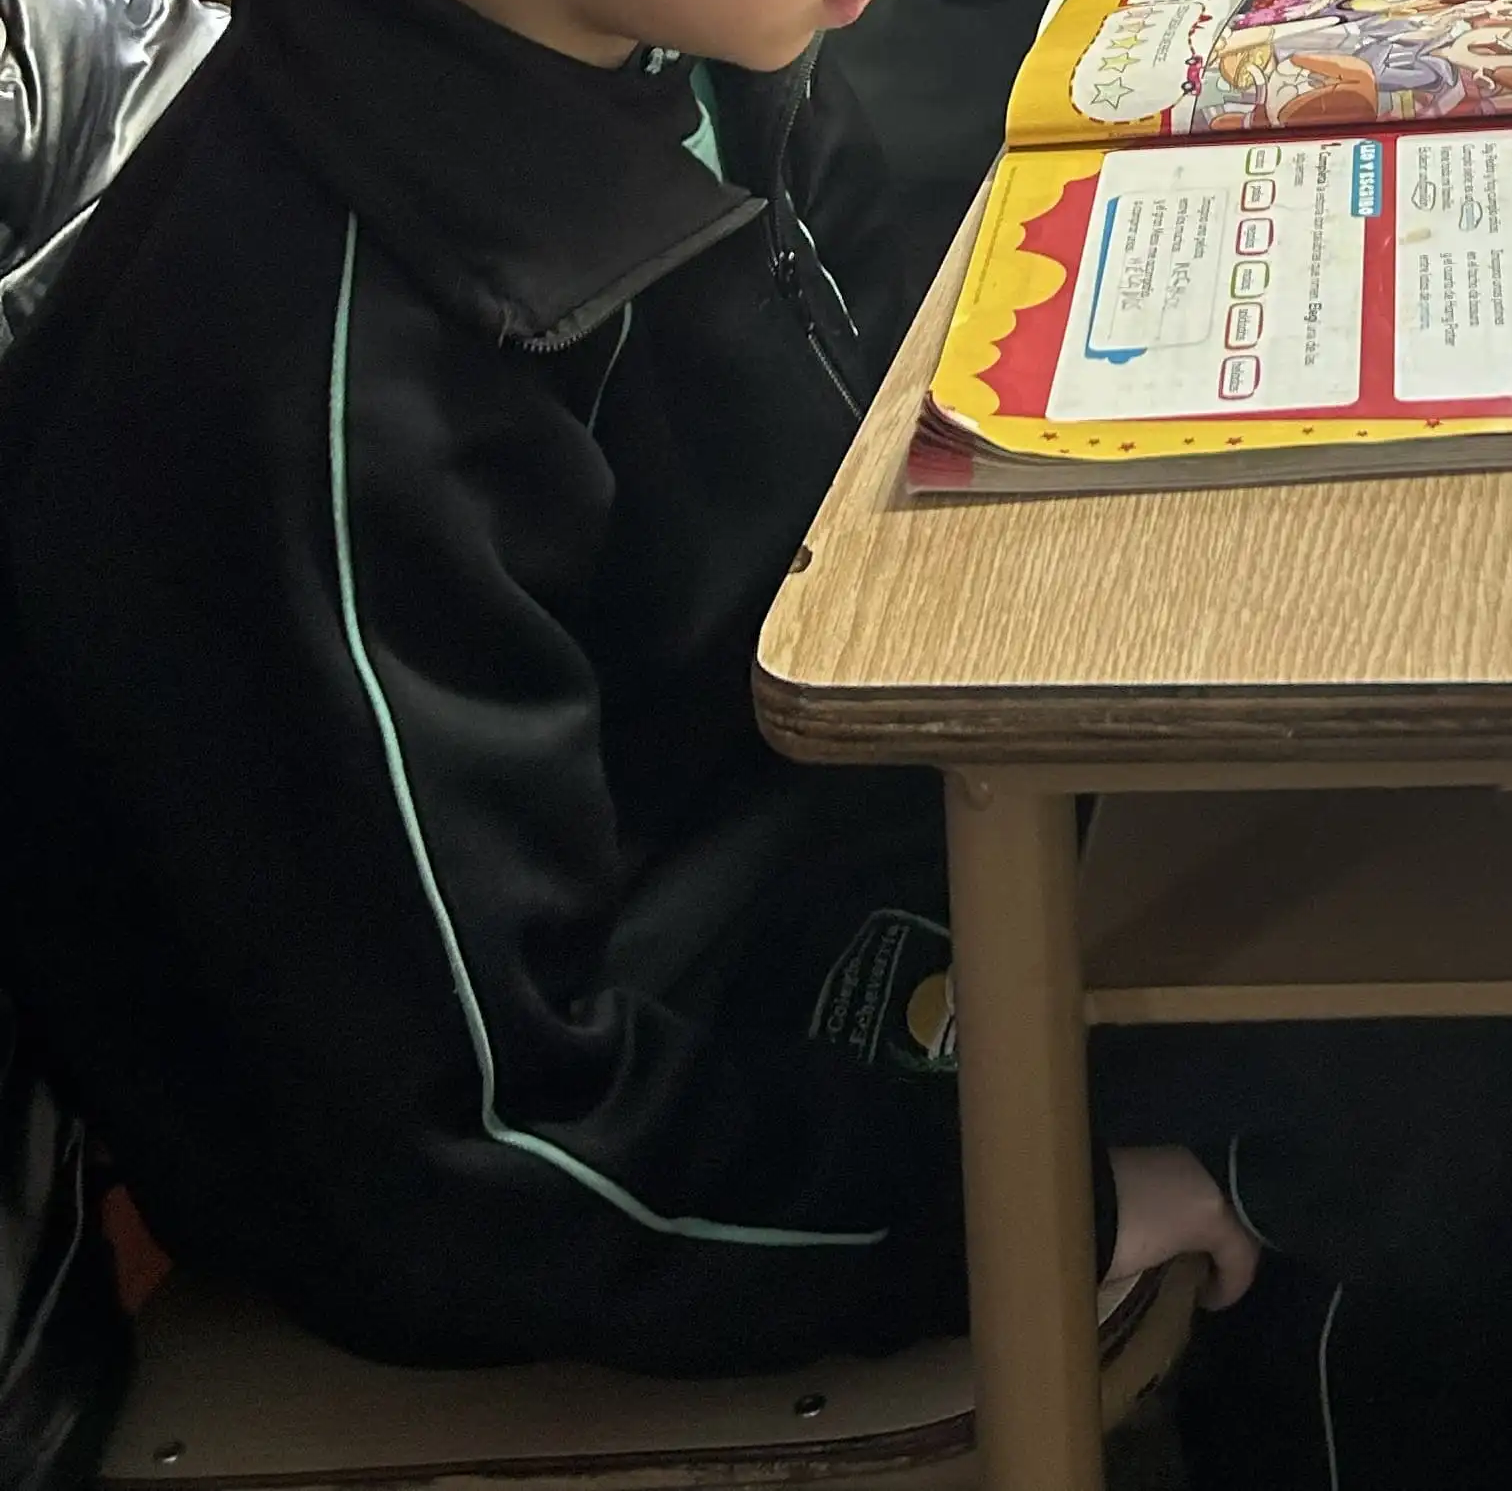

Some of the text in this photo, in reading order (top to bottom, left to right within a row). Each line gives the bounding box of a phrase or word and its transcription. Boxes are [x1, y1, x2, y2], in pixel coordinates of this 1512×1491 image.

[1358, 143, 1374, 215] LEO Y ESCRIBO
